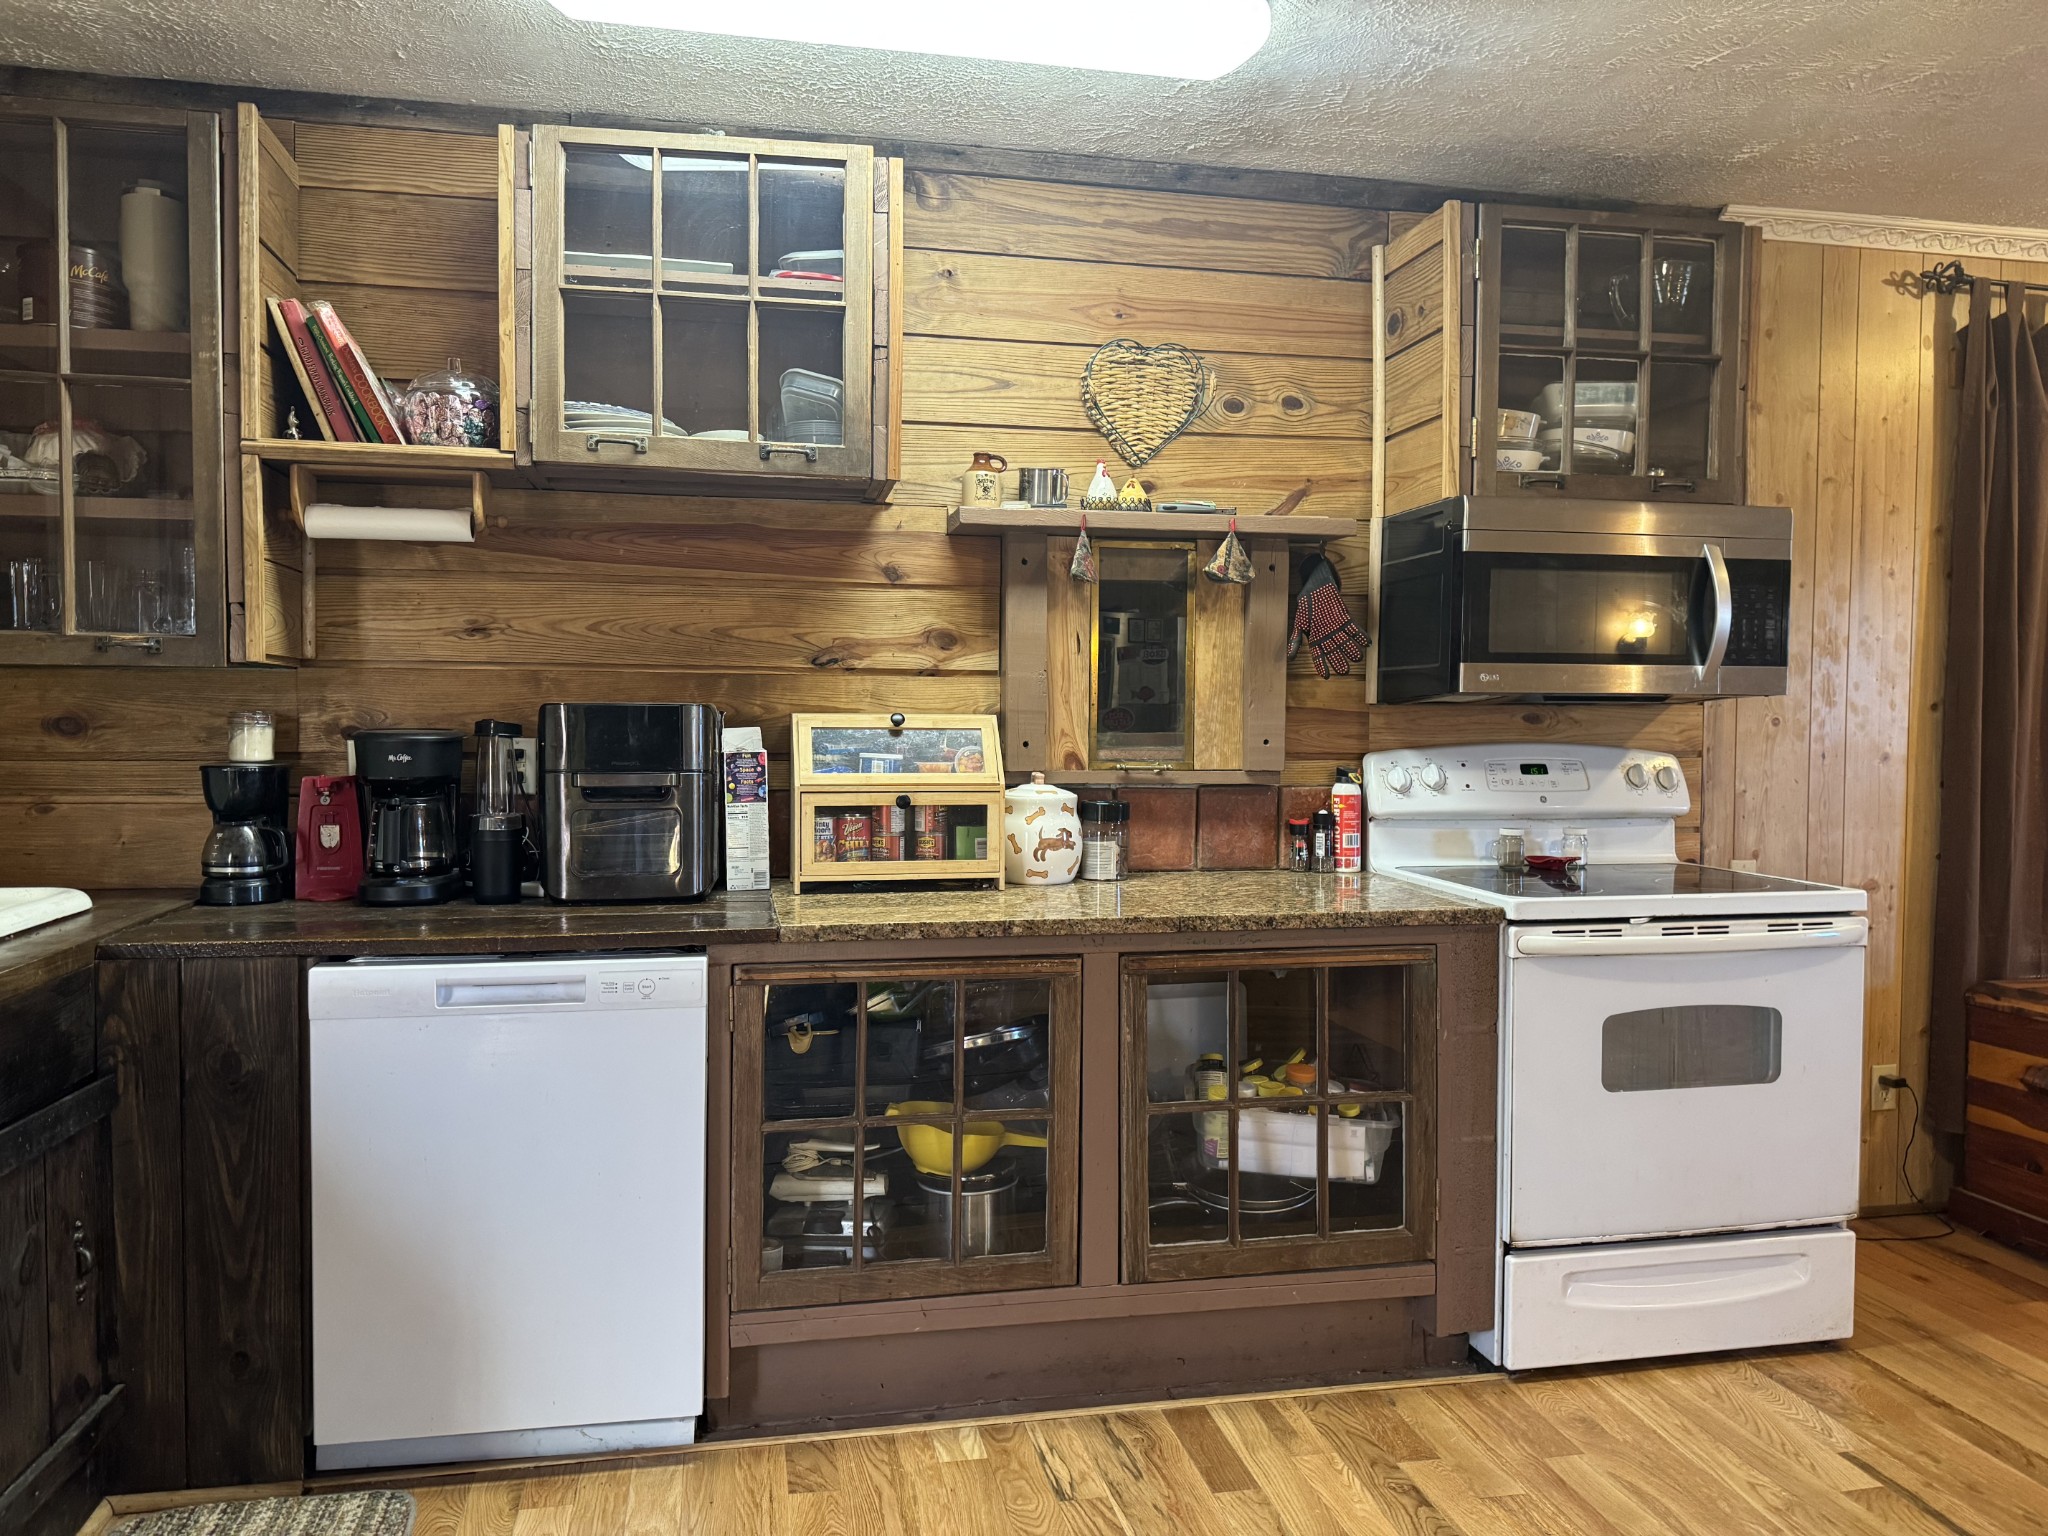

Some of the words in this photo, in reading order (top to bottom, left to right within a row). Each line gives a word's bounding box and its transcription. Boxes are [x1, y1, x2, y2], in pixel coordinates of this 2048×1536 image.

[354, 373, 390, 430] COOKBOOK
[1333, 797, 1341, 824] FIRE
[838, 839, 869, 853] CHILI
